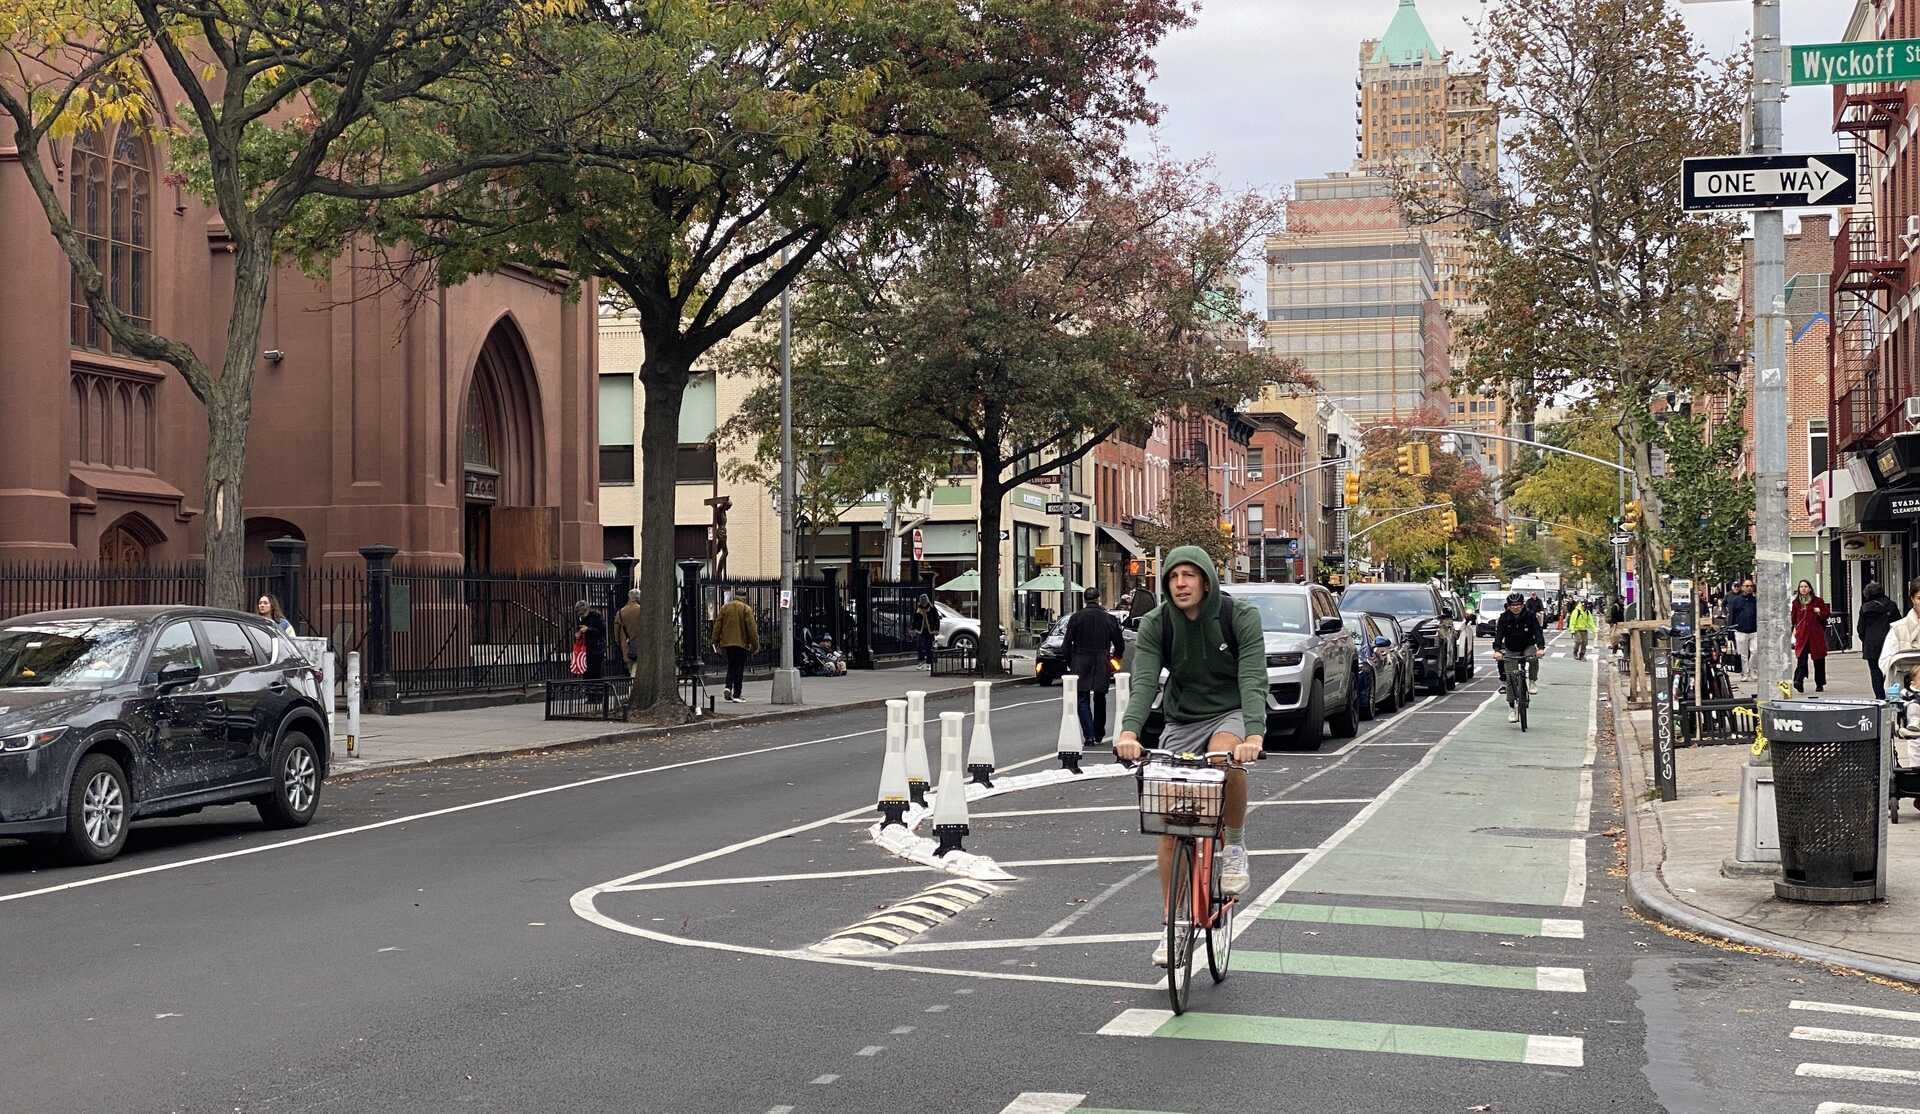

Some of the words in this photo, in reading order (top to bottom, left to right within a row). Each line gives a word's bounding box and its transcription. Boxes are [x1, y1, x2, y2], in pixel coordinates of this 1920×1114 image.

[1802, 46, 1895, 84] Wyckoff
[1708, 173, 1756, 194] ONE
[1780, 170, 1830, 191] WAY
[1773, 718, 1803, 733] NYC
